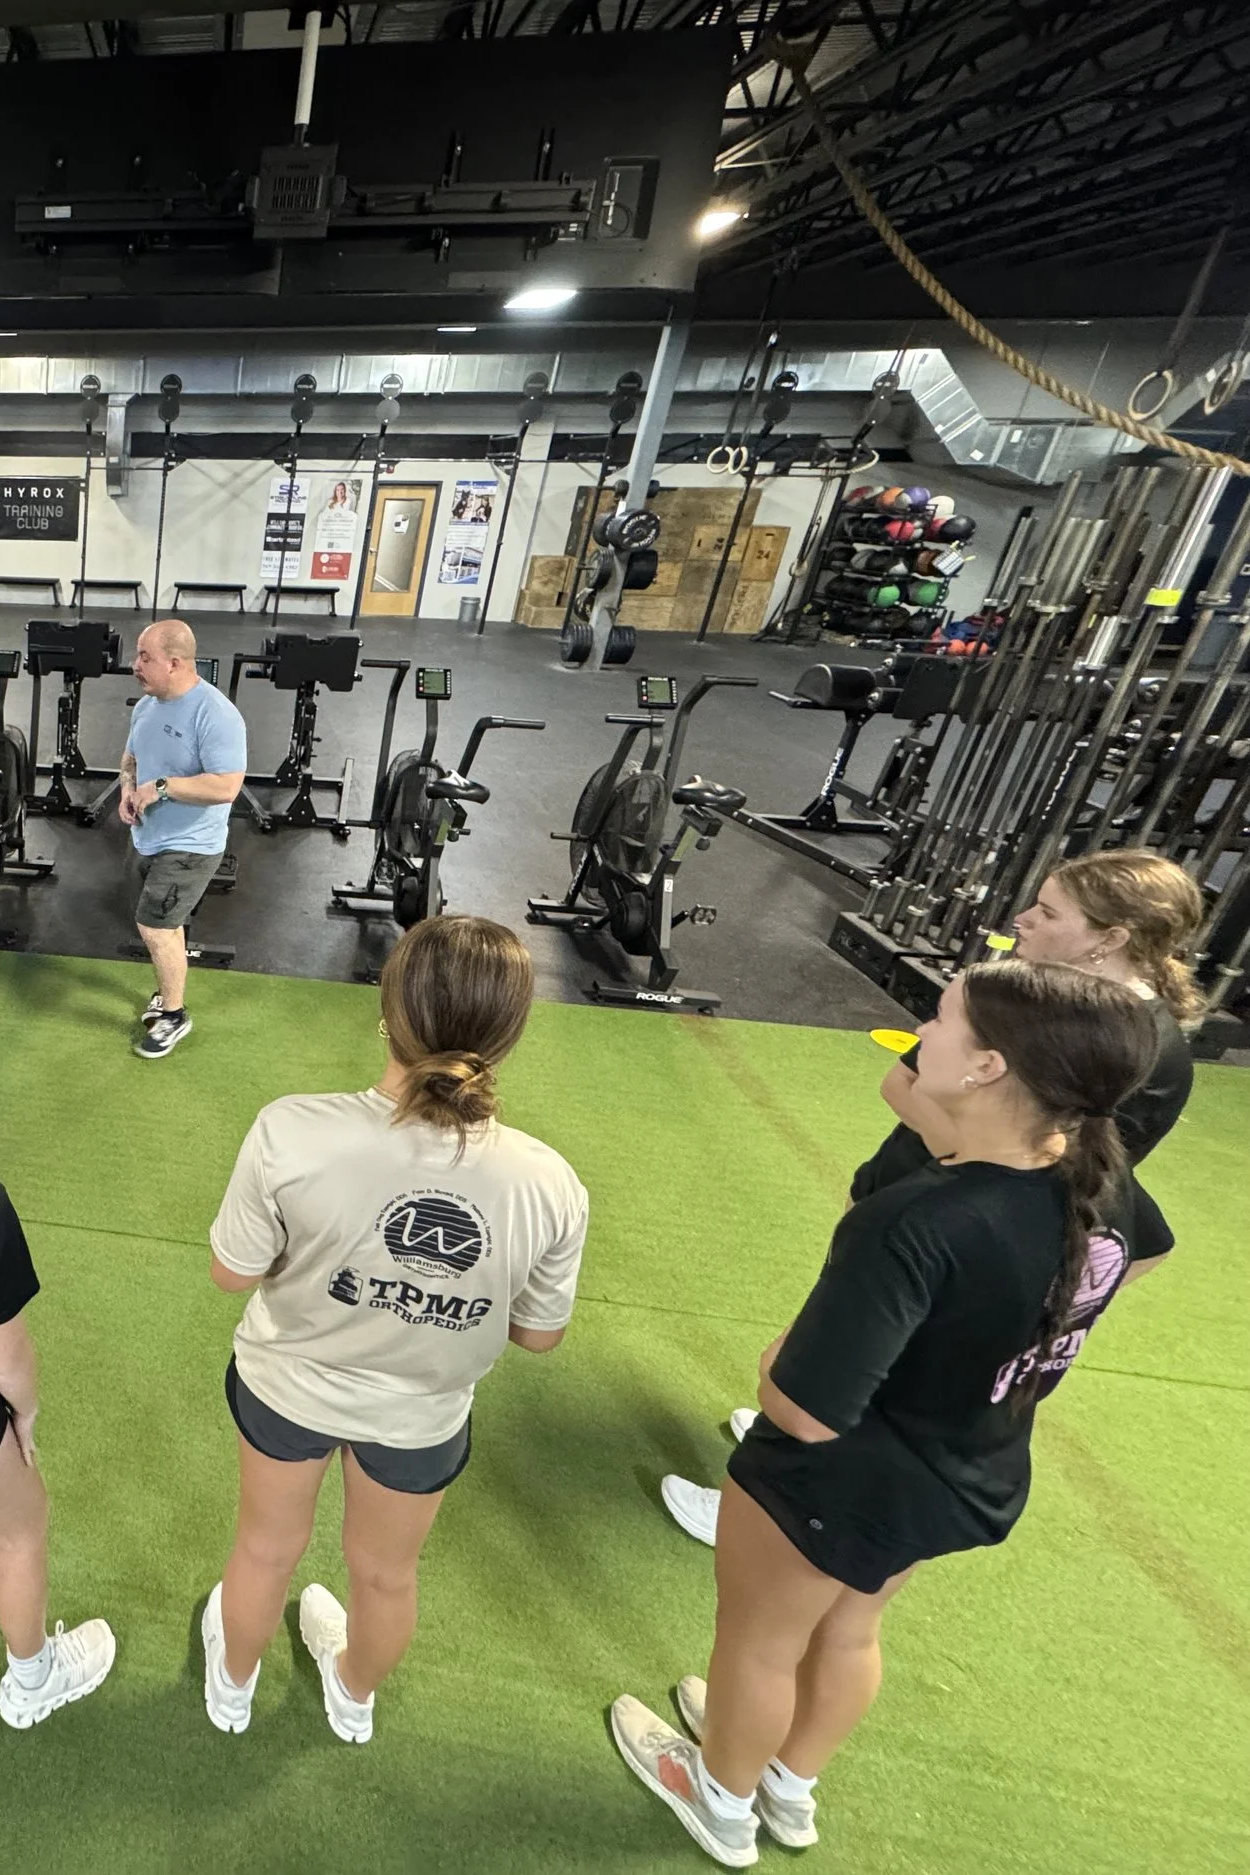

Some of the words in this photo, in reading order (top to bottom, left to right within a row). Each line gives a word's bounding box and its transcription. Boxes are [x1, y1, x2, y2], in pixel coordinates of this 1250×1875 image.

[3, 487, 64, 498] HYROX
[3, 505, 64, 518] TRAINING
[16, 518, 49, 530] CLUB
[756, 550, 771, 560] 24
[820, 747, 845, 796] ROGUE
[665, 881, 672, 890] 2
[636, 992, 685, 1004] ROGUE
[392, 1255, 462, 1280] Williamsburg
[369, 1277, 493, 1321] TPMG
[368, 1299, 482, 1332] ORTHOPEDICS
